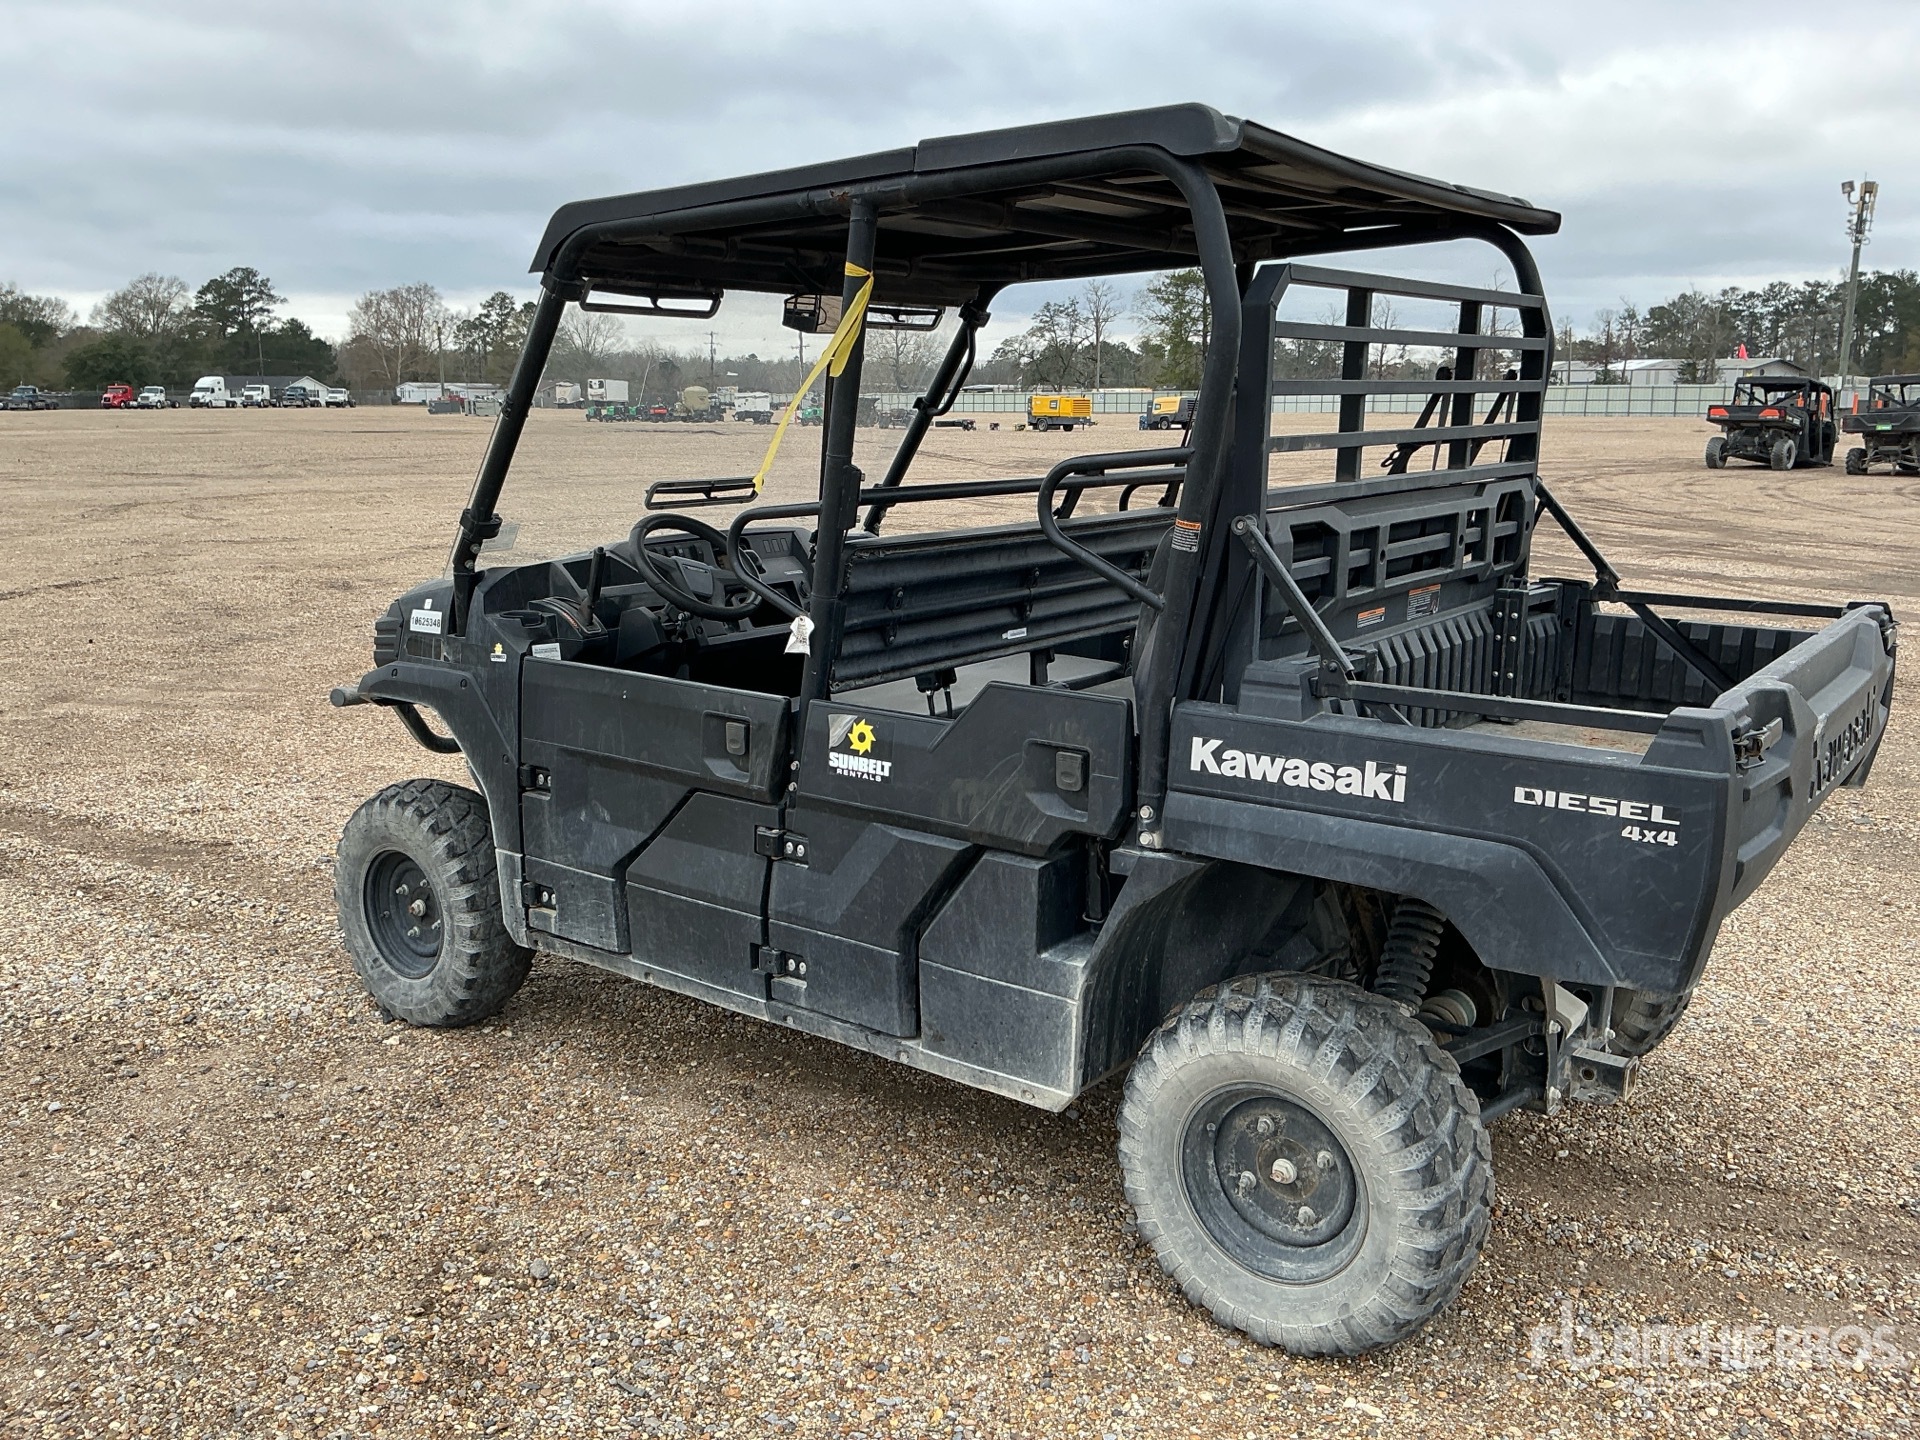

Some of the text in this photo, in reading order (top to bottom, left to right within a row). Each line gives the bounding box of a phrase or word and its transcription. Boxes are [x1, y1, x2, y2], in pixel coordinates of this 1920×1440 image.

[411, 616, 441, 628] 10625348
[828, 751, 892, 777] SUNBELT
[836, 768, 882, 782] RENTALS
[1190, 736, 1408, 803] Kawasaki
[1513, 786, 1681, 826] DIESEL
[1621, 825, 1679, 847] 4x4
